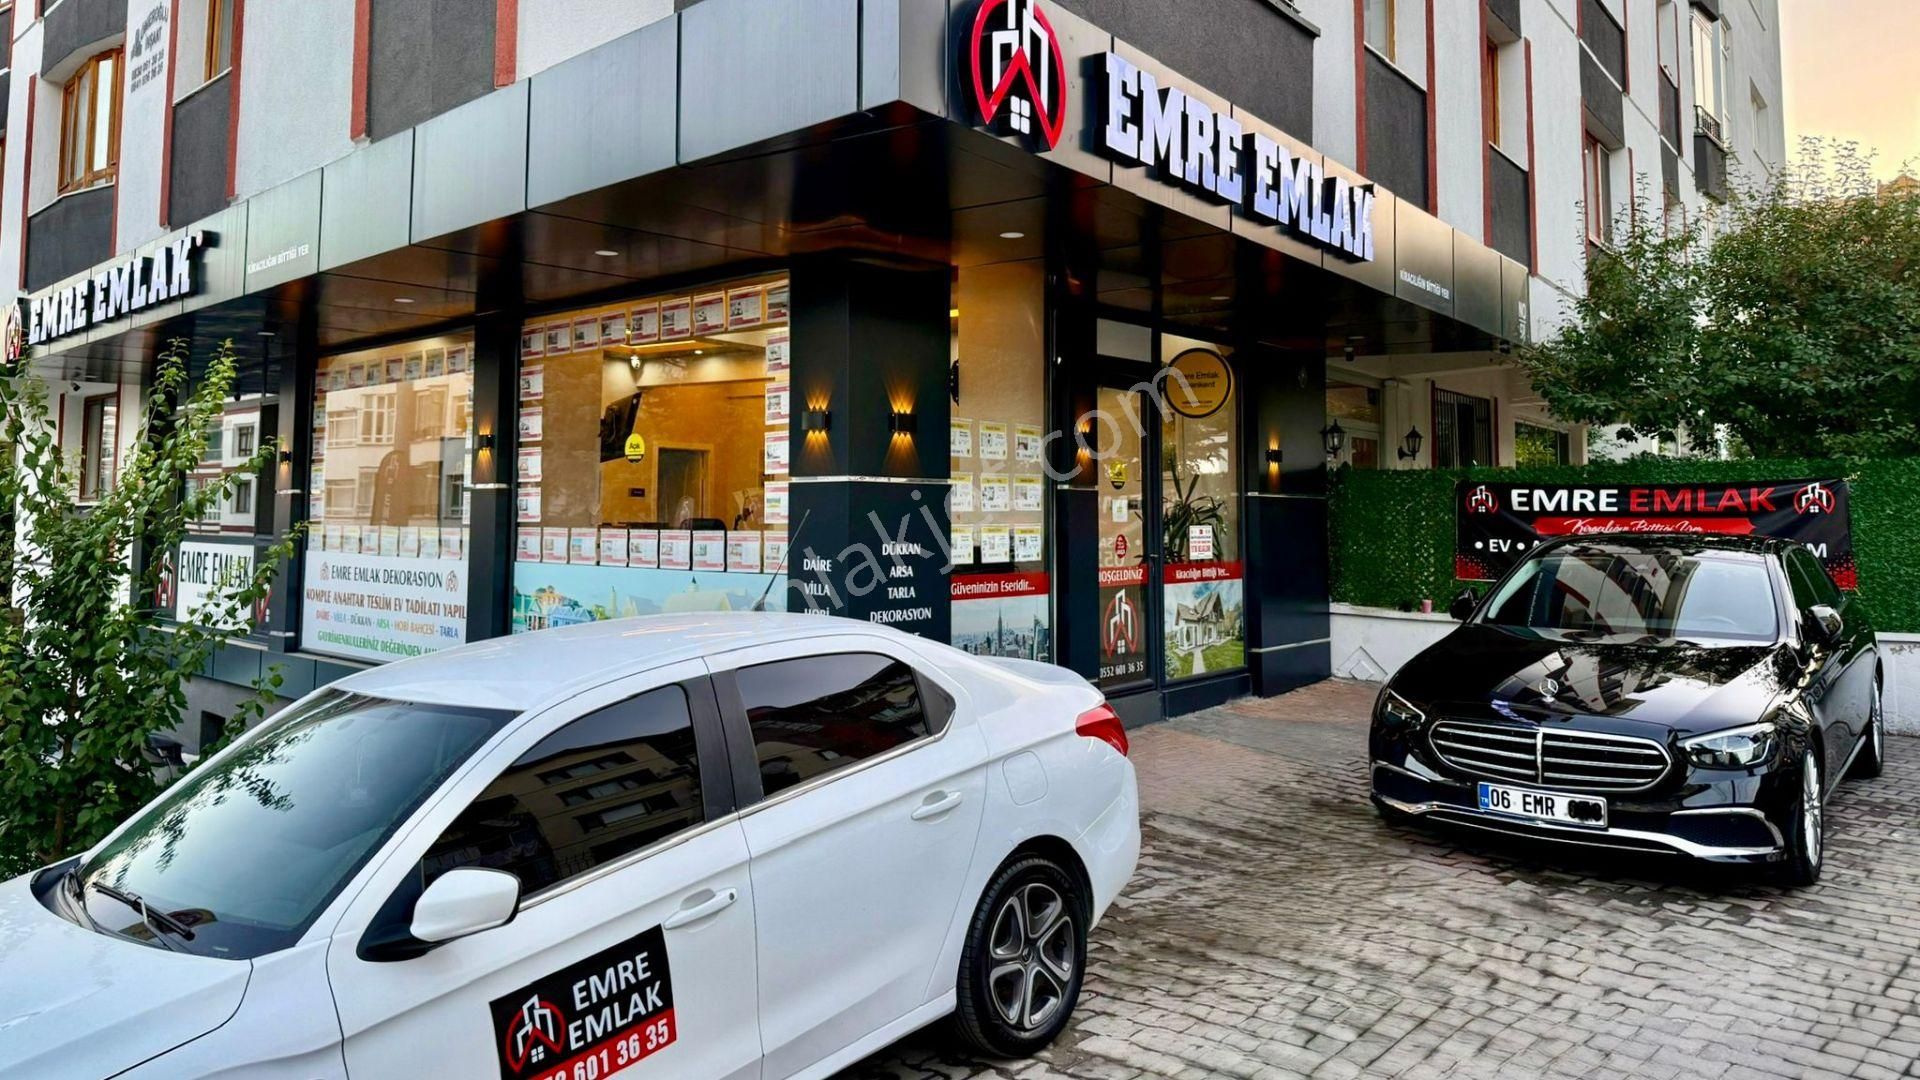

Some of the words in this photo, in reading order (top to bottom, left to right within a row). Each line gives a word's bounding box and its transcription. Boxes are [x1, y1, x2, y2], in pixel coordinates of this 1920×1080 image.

[1106, 51, 1243, 204] EMRE
[1254, 132, 1375, 262] EMLAK
[29, 280, 88, 345] EMRE
[92, 236, 192, 324] EMLAK
[1510, 488, 1619, 512] EMRE
[1630, 487, 1776, 513] EMLAK
[881, 542, 921, 556] DÜKKAN
[1489, 539, 1511, 552] EV
[181, 551, 209, 585] EMRE
[803, 556, 832, 572] DAİRE
[889, 566, 914, 578] ARSA
[331, 564, 352, 582] EMRE
[353, 567, 381, 584] EMLAK
[383, 569, 444, 589] DEKORASYON
[804, 580, 831, 596] VİLLA
[887, 587, 916, 599] TARLA
[951, 581, 999, 596] Güveninizin
[333, 593, 365, 608] ANAHTAR
[367, 593, 393, 612] TESLİM
[394, 599, 404, 612] EV
[406, 597, 441, 616] TADİLATI
[870, 607, 932, 623] DEKORASYON
[440, 625, 459, 640] TARLA
[1490, 788, 1511, 809] 06
[1522, 793, 1555, 817] EMR
[572, 951, 652, 1011] EMRE
[567, 980, 664, 1051] EMLAK
[573, 1048, 609, 1080] 601
[616, 1033, 641, 1066] 36
[646, 1018, 670, 1051] 35
